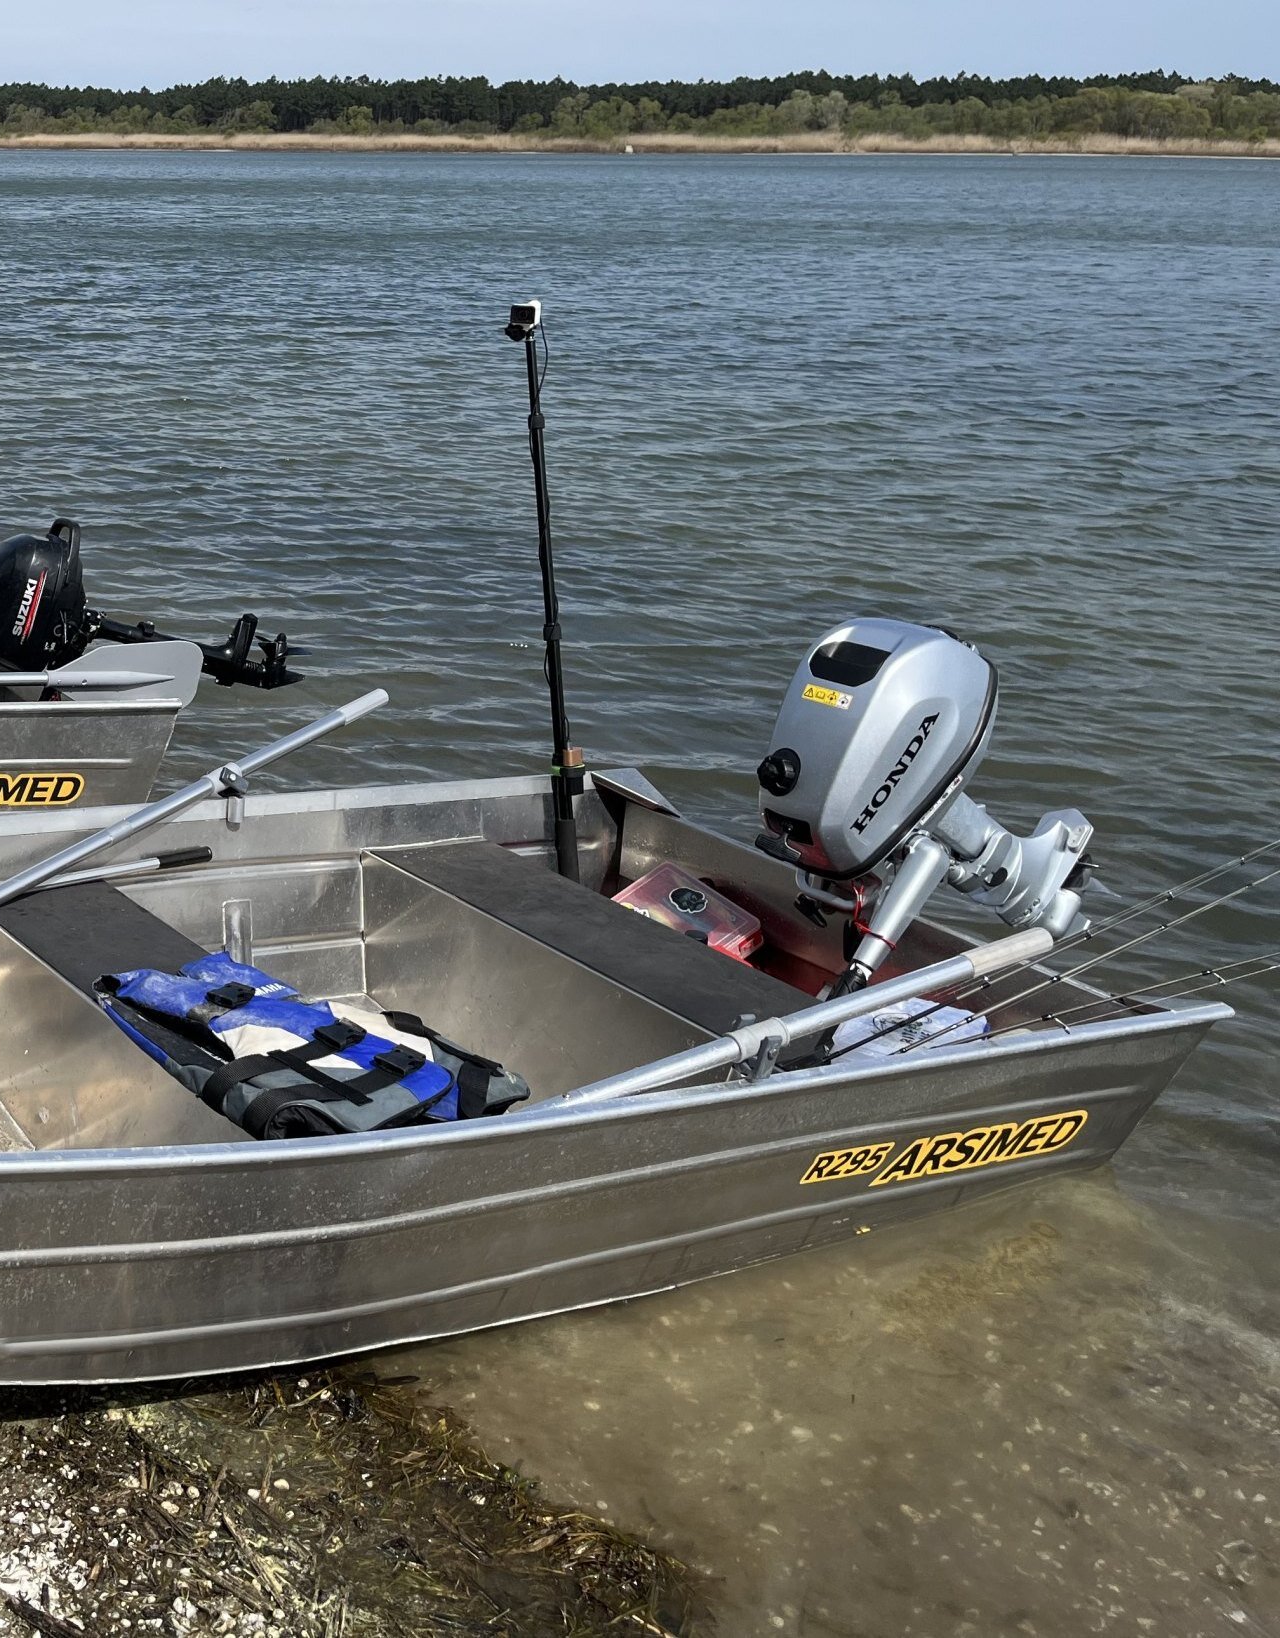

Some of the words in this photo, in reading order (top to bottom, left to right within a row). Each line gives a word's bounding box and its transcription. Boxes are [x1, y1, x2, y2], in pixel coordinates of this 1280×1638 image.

[12, 578, 38, 636] SUZUKI
[850, 712, 940, 835] HONDA
[254, 982, 286, 996] MAHA
[804, 1144, 890, 1181] R295
[879, 1114, 1084, 1181] ARSIMED
